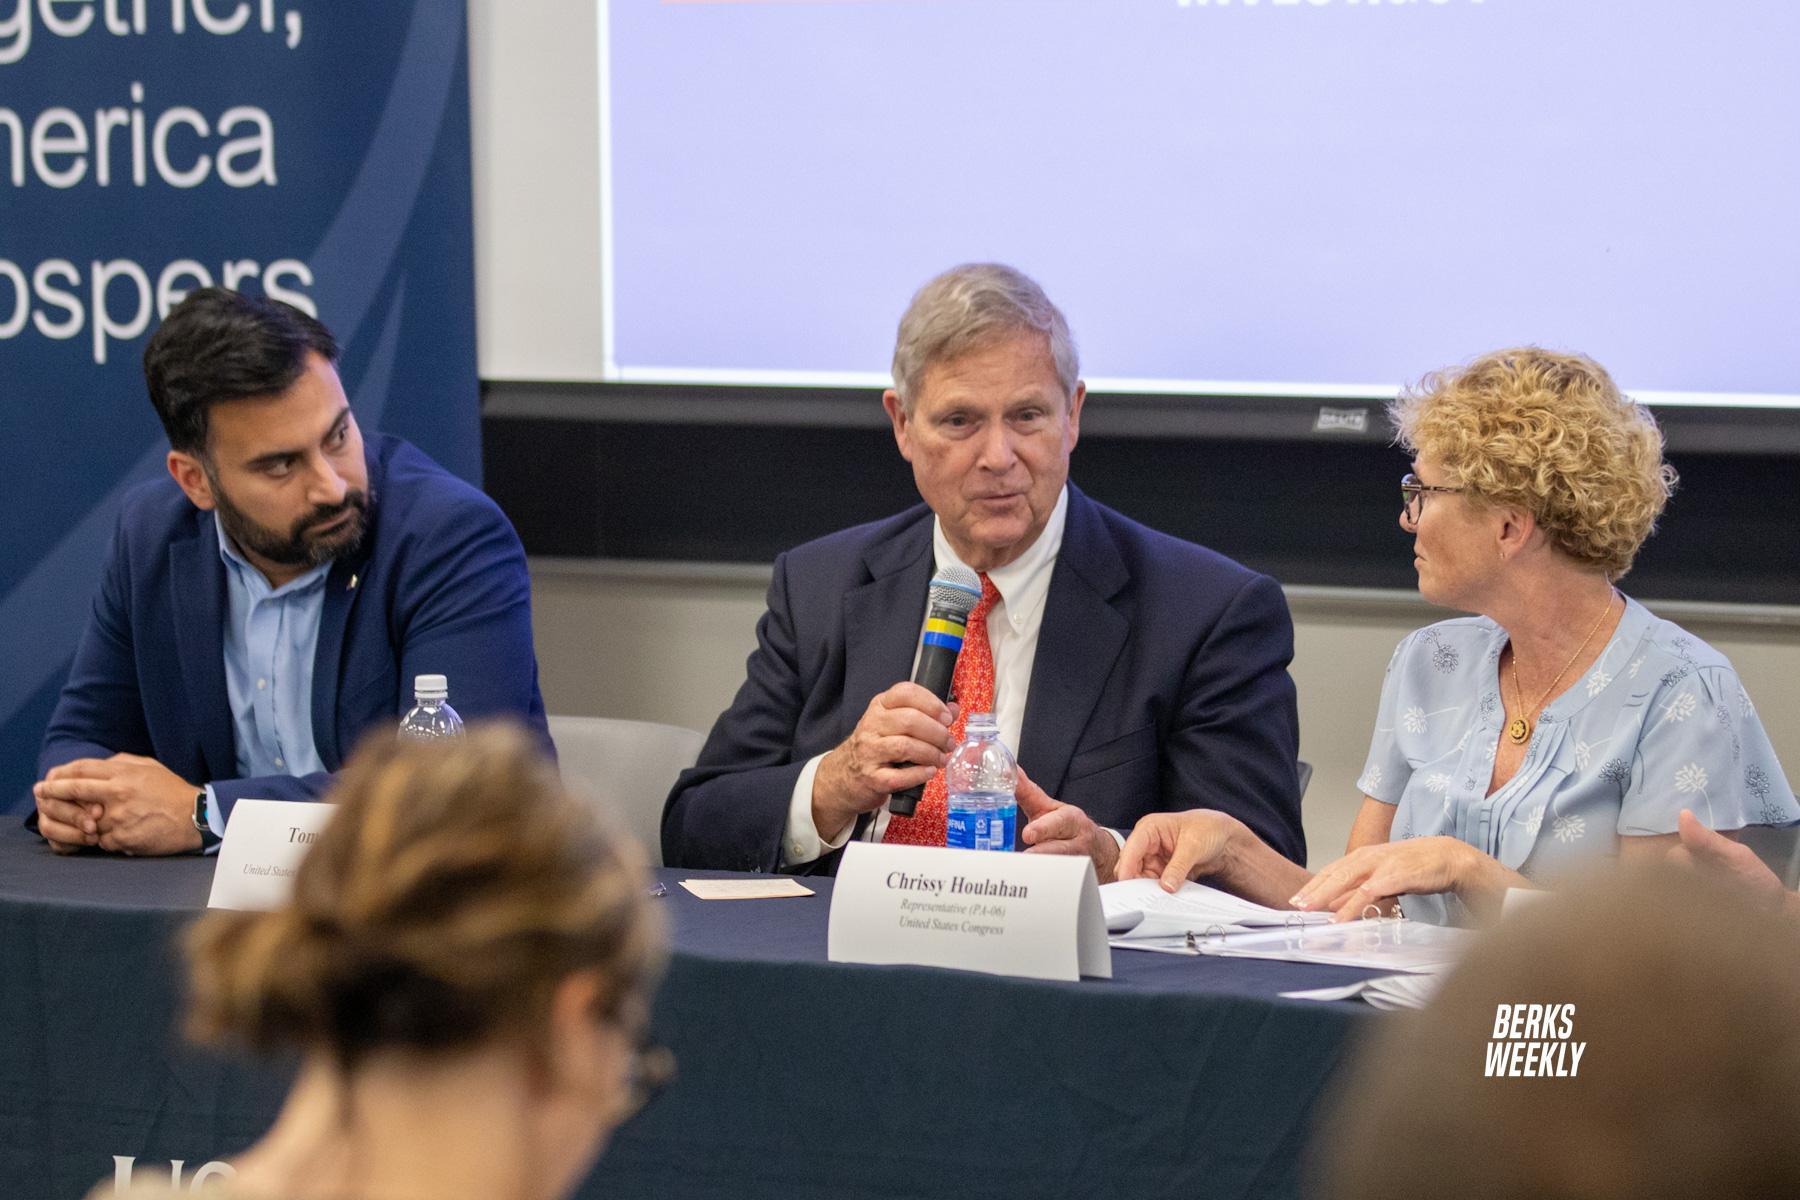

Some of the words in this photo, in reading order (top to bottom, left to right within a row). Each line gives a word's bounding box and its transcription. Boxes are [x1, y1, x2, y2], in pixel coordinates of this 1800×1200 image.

[243, 863, 271, 876] United
[886, 871, 945, 896] Chrissy
[950, 876, 1028, 899] Houlahan
[900, 898, 966, 915] Representative
[968, 904, 1006, 918] (PA-06)
[899, 915, 930, 929] United
[931, 919, 958, 932] States
[960, 921, 1004, 936] Congress
